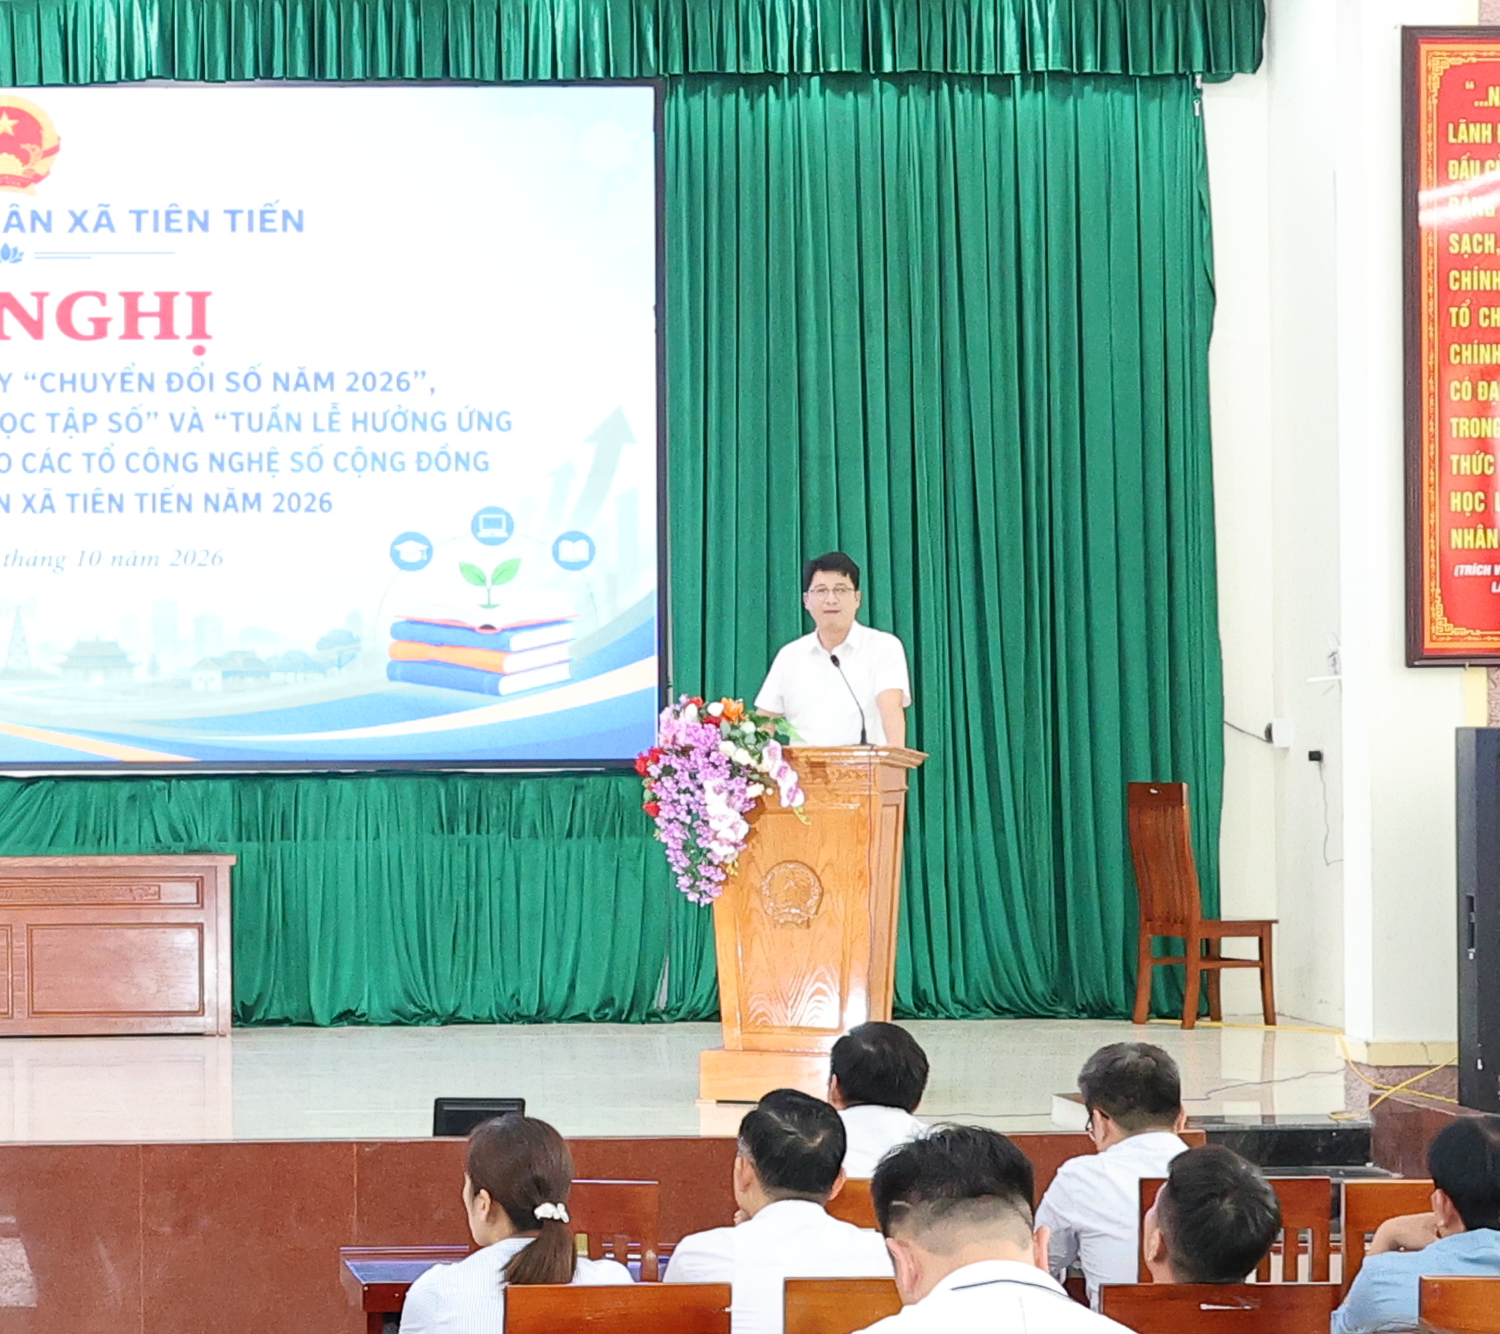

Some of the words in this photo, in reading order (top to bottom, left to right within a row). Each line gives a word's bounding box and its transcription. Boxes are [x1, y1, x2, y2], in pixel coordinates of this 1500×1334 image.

[1448, 118, 1493, 144] LÃNH
[68, 203, 116, 233] XÃ
[129, 203, 209, 233] TIÊN
[223, 199, 304, 233] TIẾN
[1448, 298, 1471, 328] TỔ
[165, 362, 214, 393] ĐỔI
[225, 363, 262, 393] SỐ
[273, 366, 334, 392] NĂM
[46, 407, 98, 439] TẬP
[169, 406, 204, 433] VÀ
[313, 403, 341, 433] LỄ
[352, 405, 447, 433] HƯỞNG
[458, 405, 512, 432] ỨNG
[22, 447, 72, 474] CÁC
[82, 443, 115, 473] TỔ
[125, 447, 198, 473] CÔNG
[209, 446, 280, 478] NGHỆ
[290, 444, 324, 473] SỐ
[333, 446, 406, 478] CỘNG
[22, 488, 56, 514] XÃ
[65, 487, 124, 514] TIÊN
[134, 485, 192, 513] TIẾN
[204, 487, 261, 513] NĂM
[273, 492, 333, 513] 2026
[3, 548, 66, 574] tháng
[78, 550, 102, 567] 10
[111, 547, 159, 566] năm
[169, 549, 223, 567] 2026
